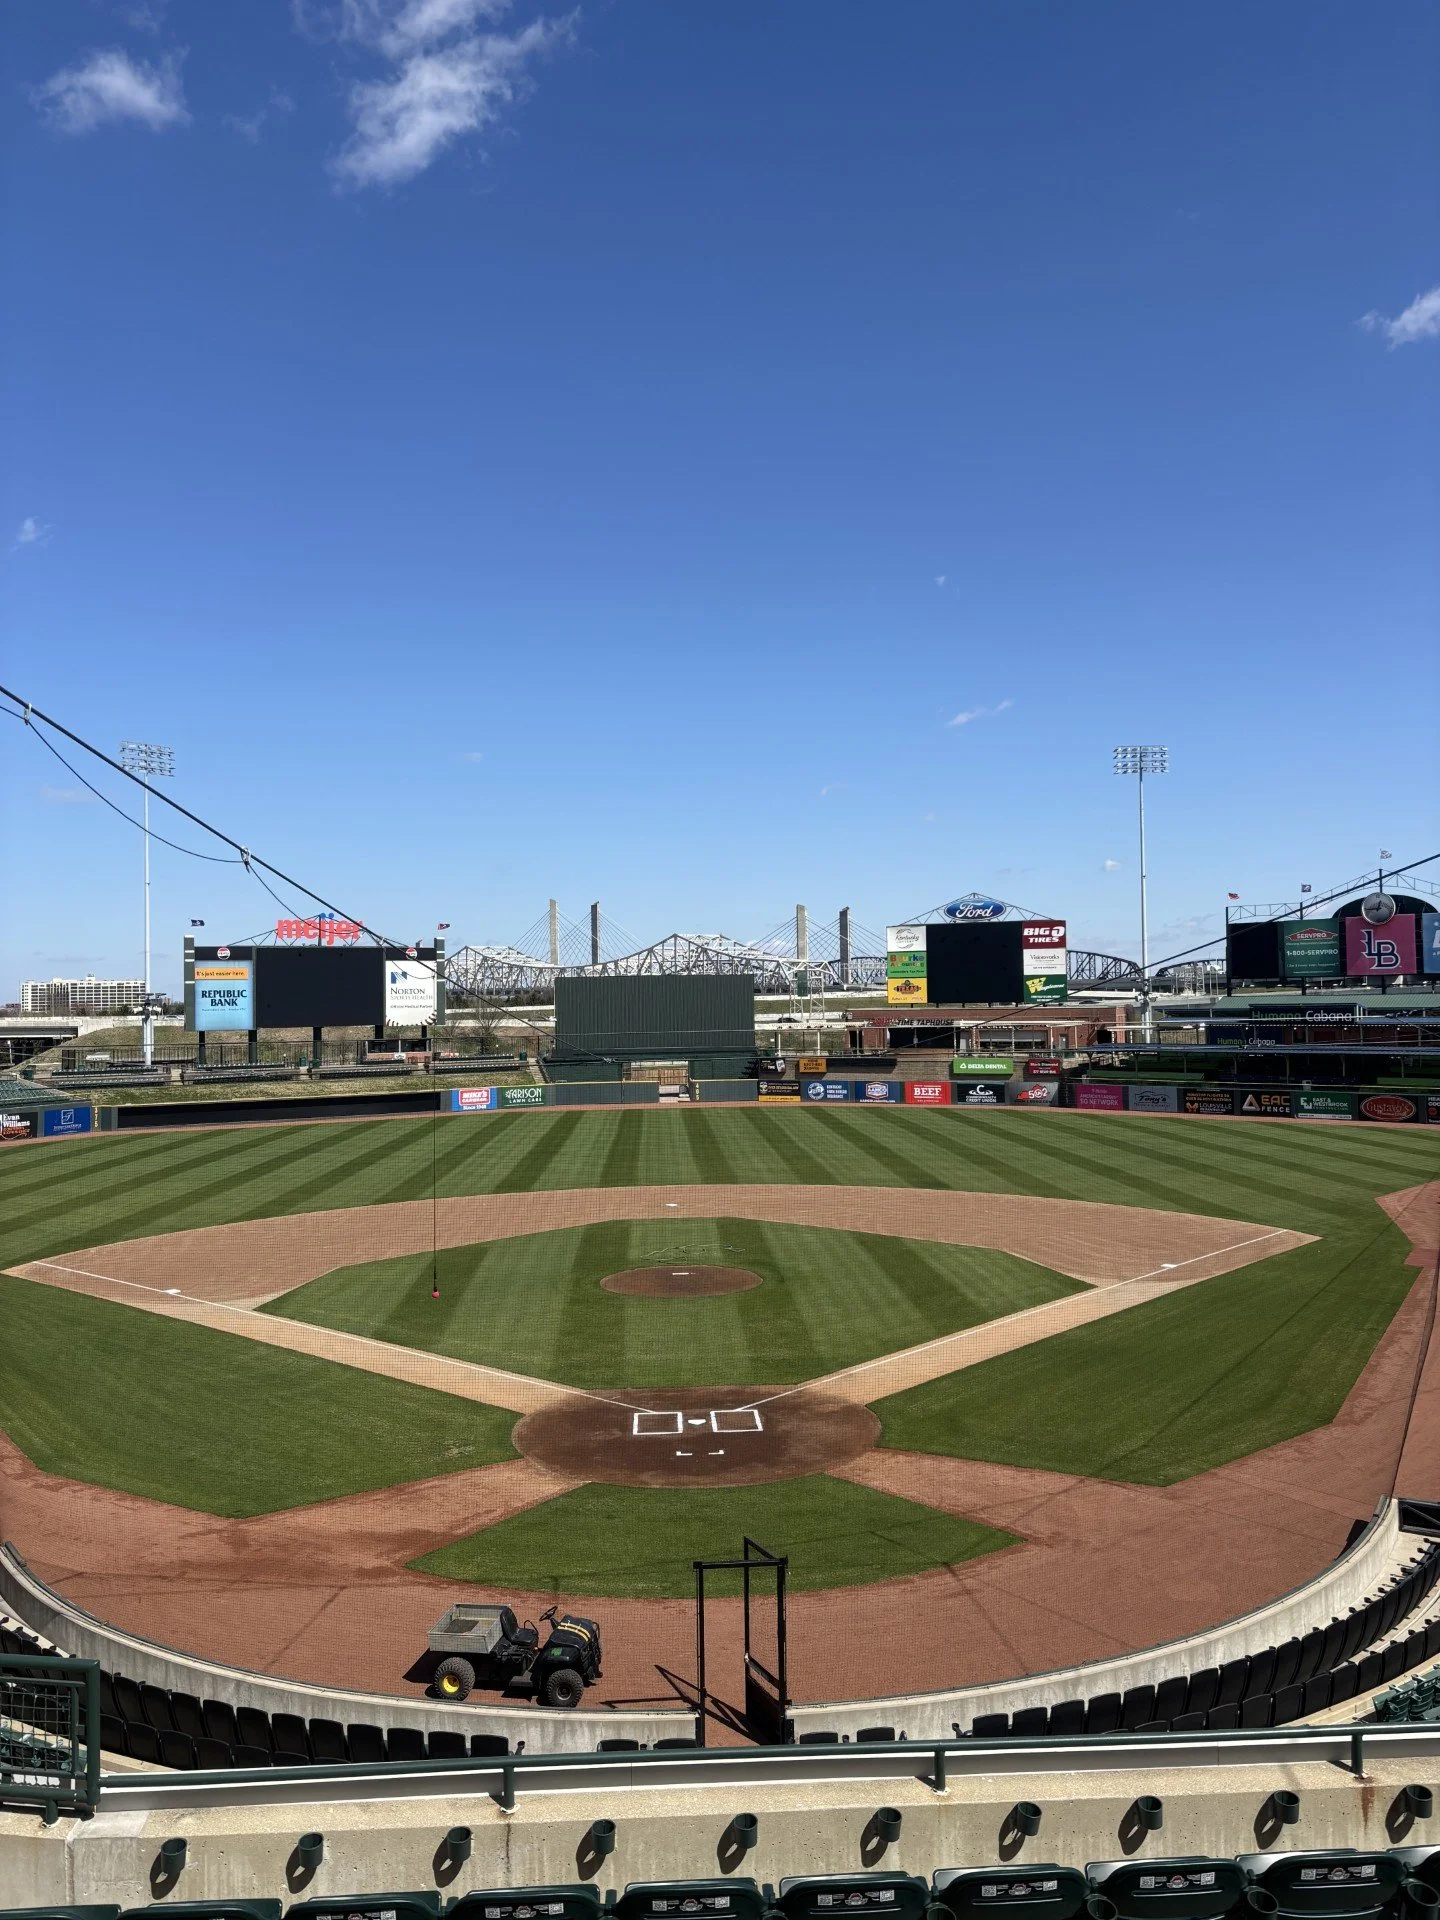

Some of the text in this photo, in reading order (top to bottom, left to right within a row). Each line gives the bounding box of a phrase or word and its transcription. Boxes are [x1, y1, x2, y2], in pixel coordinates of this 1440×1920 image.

[956, 902, 994, 918] Ford
[277, 912, 363, 946] meijer
[1023, 926, 1065, 937] BIG O
[895, 933, 920, 942] Kentucky
[889, 953, 924, 962] Bourke
[201, 989, 248, 999] REPUBLIC
[210, 998, 239, 1007] BANK
[1252, 1010, 1352, 1022] Humana Cabana
[898, 1018, 915, 1026] TIME
[916, 1018, 955, 1026] TAPHOUSE
[507, 1088, 542, 1099] FARISON
[913, 1087, 942, 1096] BEEF
[1089, 1098, 1119, 1106] NETWORK
[1138, 1095, 1167, 1104] Tony's
[1261, 1095, 1290, 1106] EAC
[1366, 1101, 1410, 1113] Gustavo's
[3, 1113, 20, 1121] Evan
[3, 1120, 31, 1128] Williams
